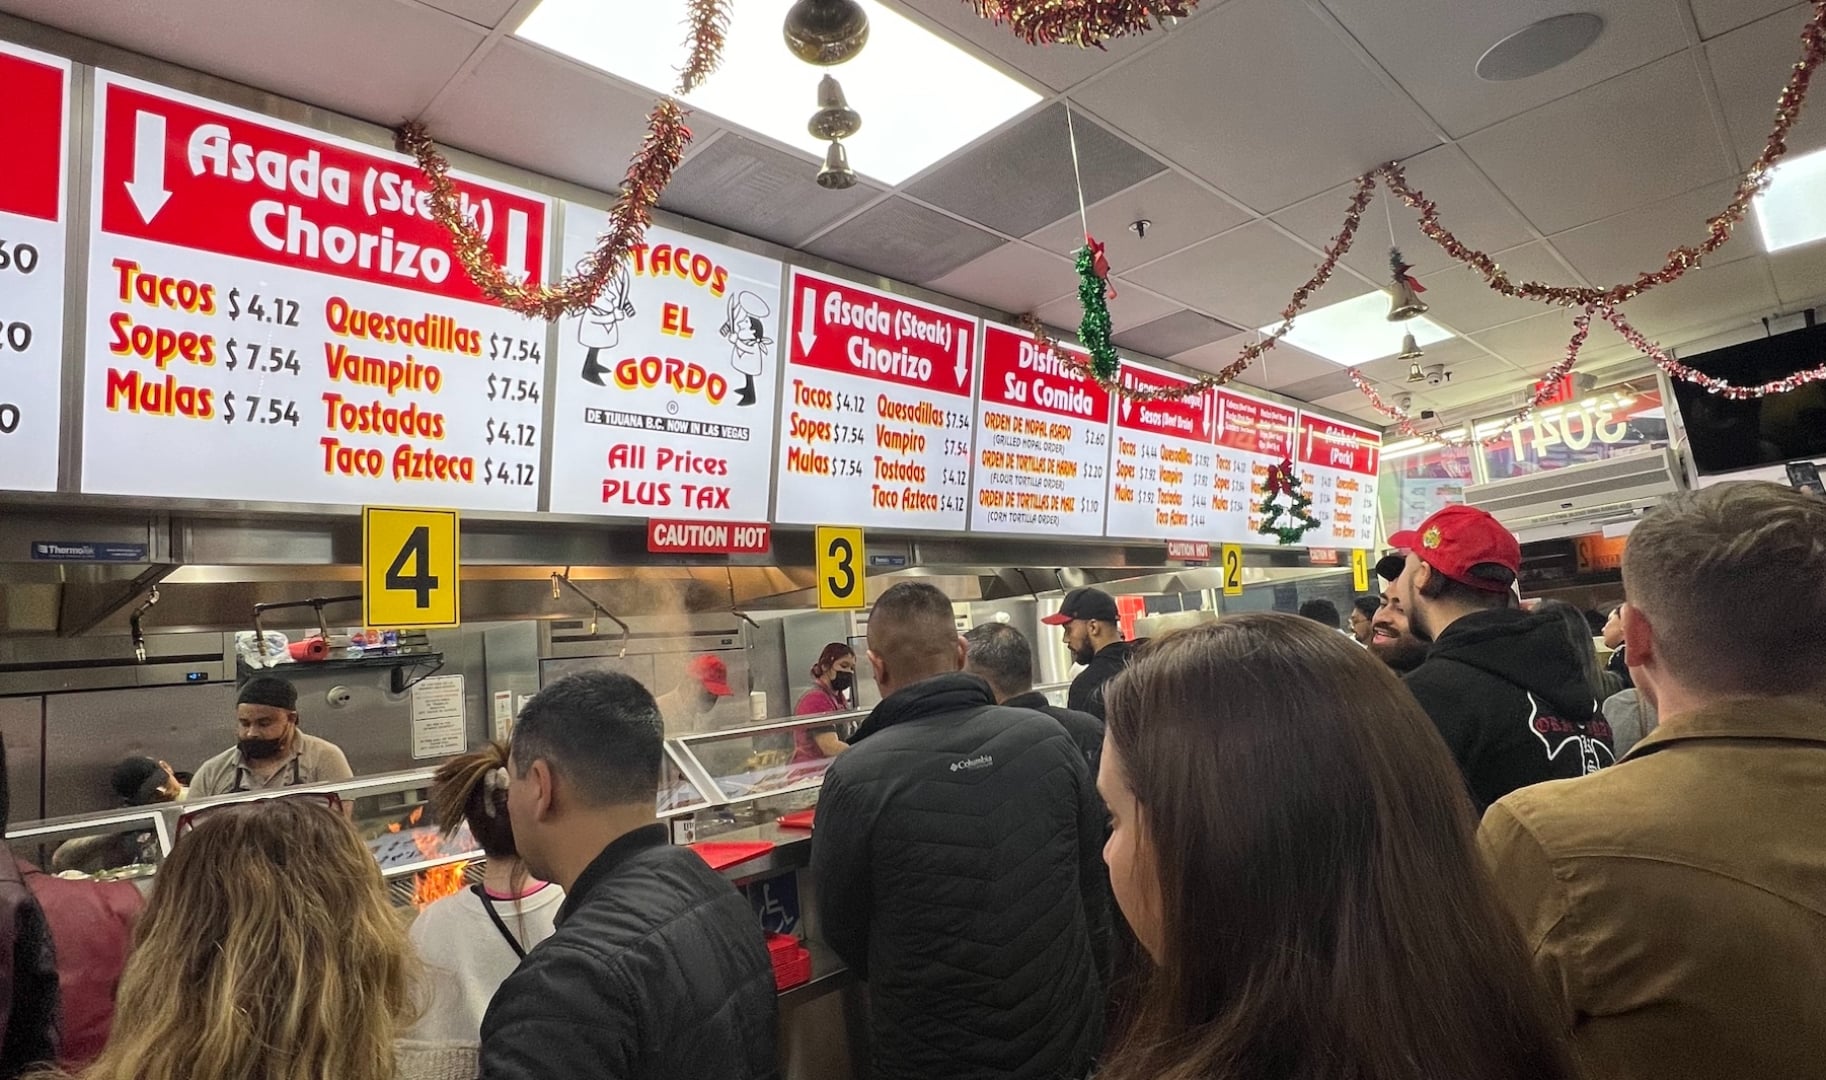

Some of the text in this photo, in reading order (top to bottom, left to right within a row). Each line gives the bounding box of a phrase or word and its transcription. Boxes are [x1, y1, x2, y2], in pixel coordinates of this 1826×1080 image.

[188, 124, 493, 243] Asada (Stek)
[250, 200, 450, 283] Chorizo
[112, 258, 216, 315] Tacos
[630, 243, 728, 298] TACOS
[325, 296, 541, 364] Quesadillas $7.54
[661, 302, 694, 338] EL
[824, 292, 951, 352] Asada (Steak)
[109, 312, 215, 369] Sopes
[324, 343, 539, 404] Vampiro $7.54
[847, 336, 932, 381] Chorizo
[106, 367, 214, 420] Mulas
[614, 356, 727, 407] GORDO
[793, 379, 864, 413] Tacos $4.12
[1004, 371, 1027, 402] Su
[1033, 378, 1093, 415] Comida
[322, 392, 535, 447] Tostadas $4.12
[588, 410, 748, 440] DE TIJUANA B.C. NOW IN LAS VEGAS
[877, 394, 943, 427] Quesadillas
[984, 411, 1011, 431] ORDEN
[1013, 416, 1023, 432] DE
[1025, 418, 1047, 437] NOPAL
[1050, 422, 1072, 441] ASADO
[1140, 406, 1161, 426] Sesos
[790, 412, 864, 444] Sopes $7.54
[876, 423, 925, 455] Vampiro
[608, 444, 727, 476] All Prices
[787, 446, 829, 474] Mulas
[993, 435, 1020, 447] (GRILLED
[1044, 441, 1065, 455] ORDER)
[1119, 436, 1136, 456] Tacos
[320, 437, 534, 486] Taco Azteca $4.12
[874, 456, 925, 483] Tostadas
[982, 450, 1004, 468] ORDEN
[1006, 452, 1014, 469] DE
[1016, 454, 1046, 473] TORTILLAS
[1047, 459, 1055, 473] DE
[1116, 459, 1135, 481] Sopes
[602, 479, 730, 510] PLUS TAX
[991, 473, 1064, 491] (FLOUR TORTILLA ORDER)
[1115, 483, 1133, 501] Mulas
[872, 485, 898, 509] Taco
[902, 487, 937, 512] Azteca
[979, 489, 1004, 507] ORDEN
[1005, 491, 1015, 507] DE
[1017, 491, 1049, 511] TORTILLAS
[1051, 496, 1059, 511] DE
[988, 511, 1007, 523] (CORN
[654, 524, 766, 547] CAUTION HOT
[1169, 541, 1209, 557] CAUTION HOT
[386, 526, 438, 608] 4
[828, 537, 854, 598] 3
[1228, 550, 1238, 587] 2
[1355, 555, 1364, 585] 1
